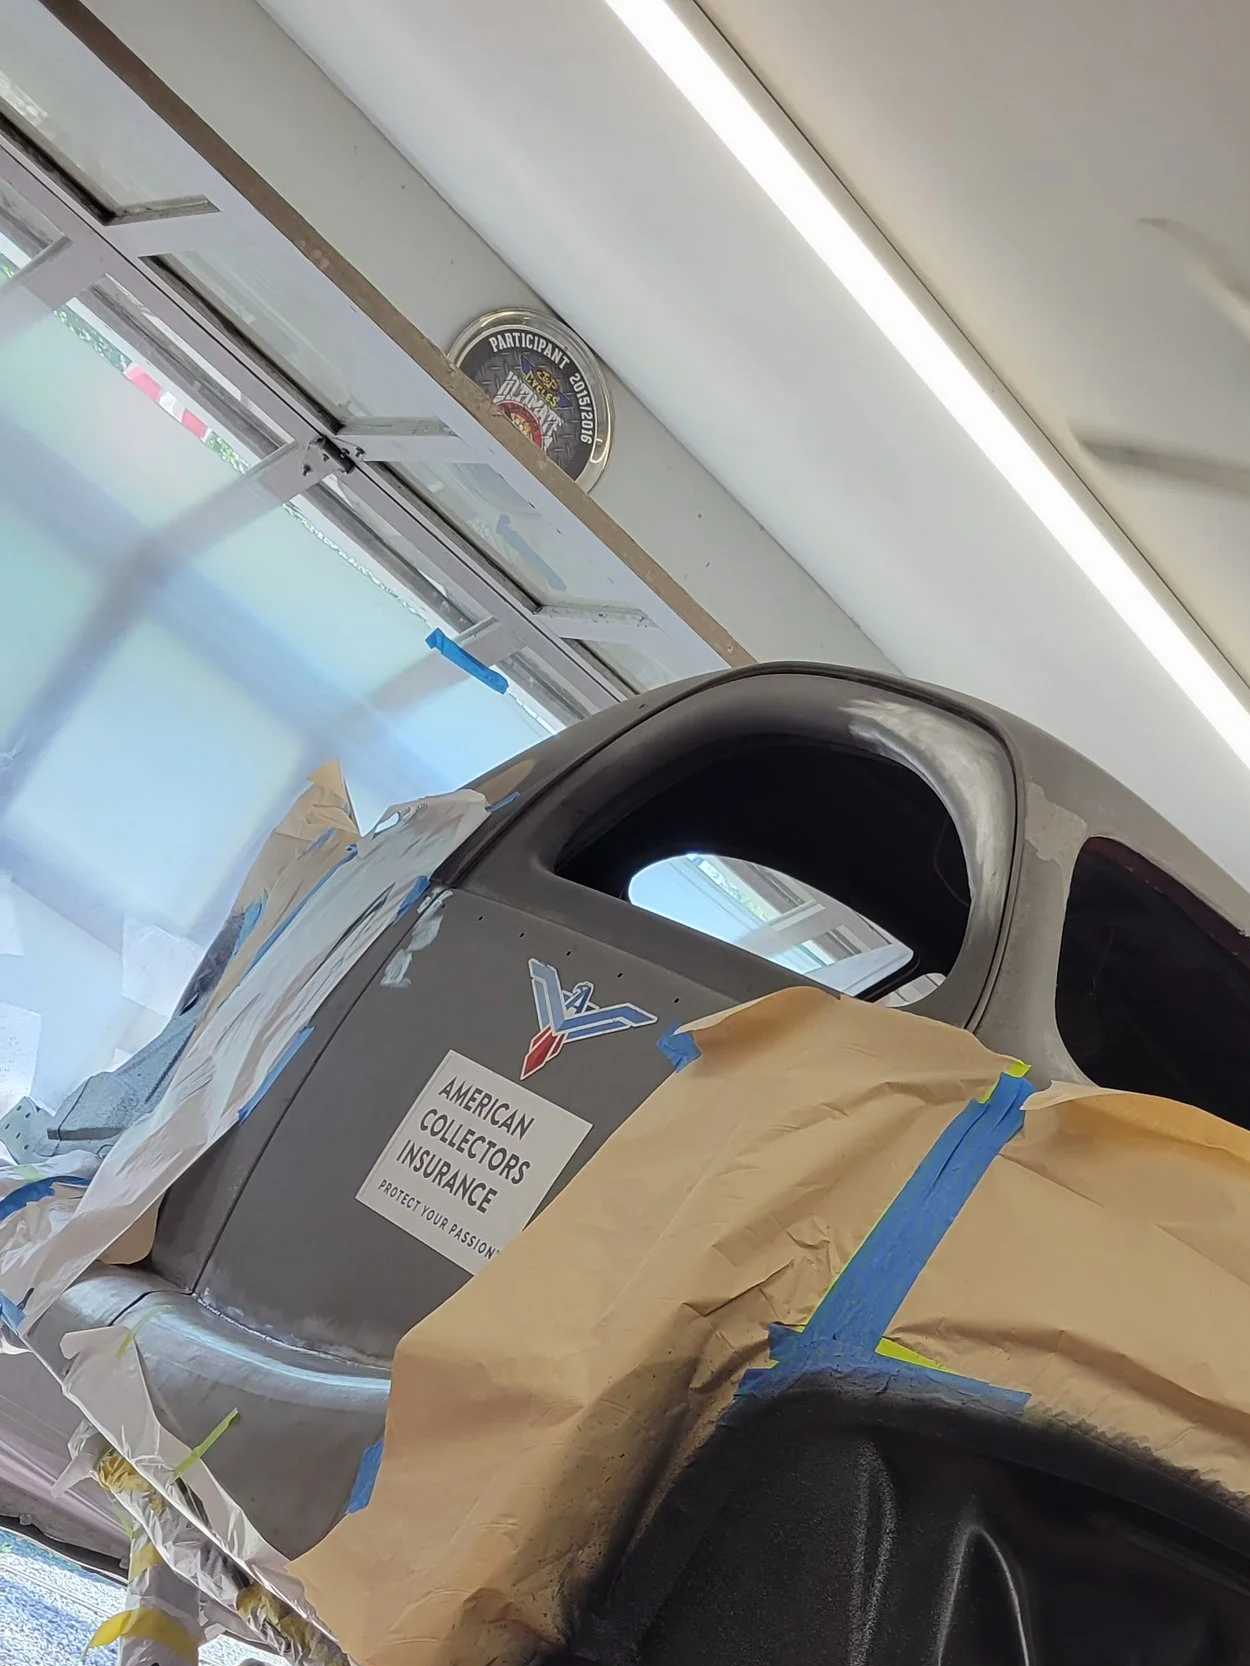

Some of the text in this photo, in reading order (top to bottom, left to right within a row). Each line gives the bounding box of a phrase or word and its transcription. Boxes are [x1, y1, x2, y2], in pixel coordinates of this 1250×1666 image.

[489, 332, 592, 445] PARTICIPANT 2015/2016
[525, 373, 559, 407] CYCLES
[438, 1076, 536, 1141] AMERICAN
[397, 1139, 499, 1215] INSURANCE
[419, 1108, 531, 1186] COLLECTORS
[378, 1179, 422, 1213] PROTECT
[420, 1204, 449, 1230] YOUR
